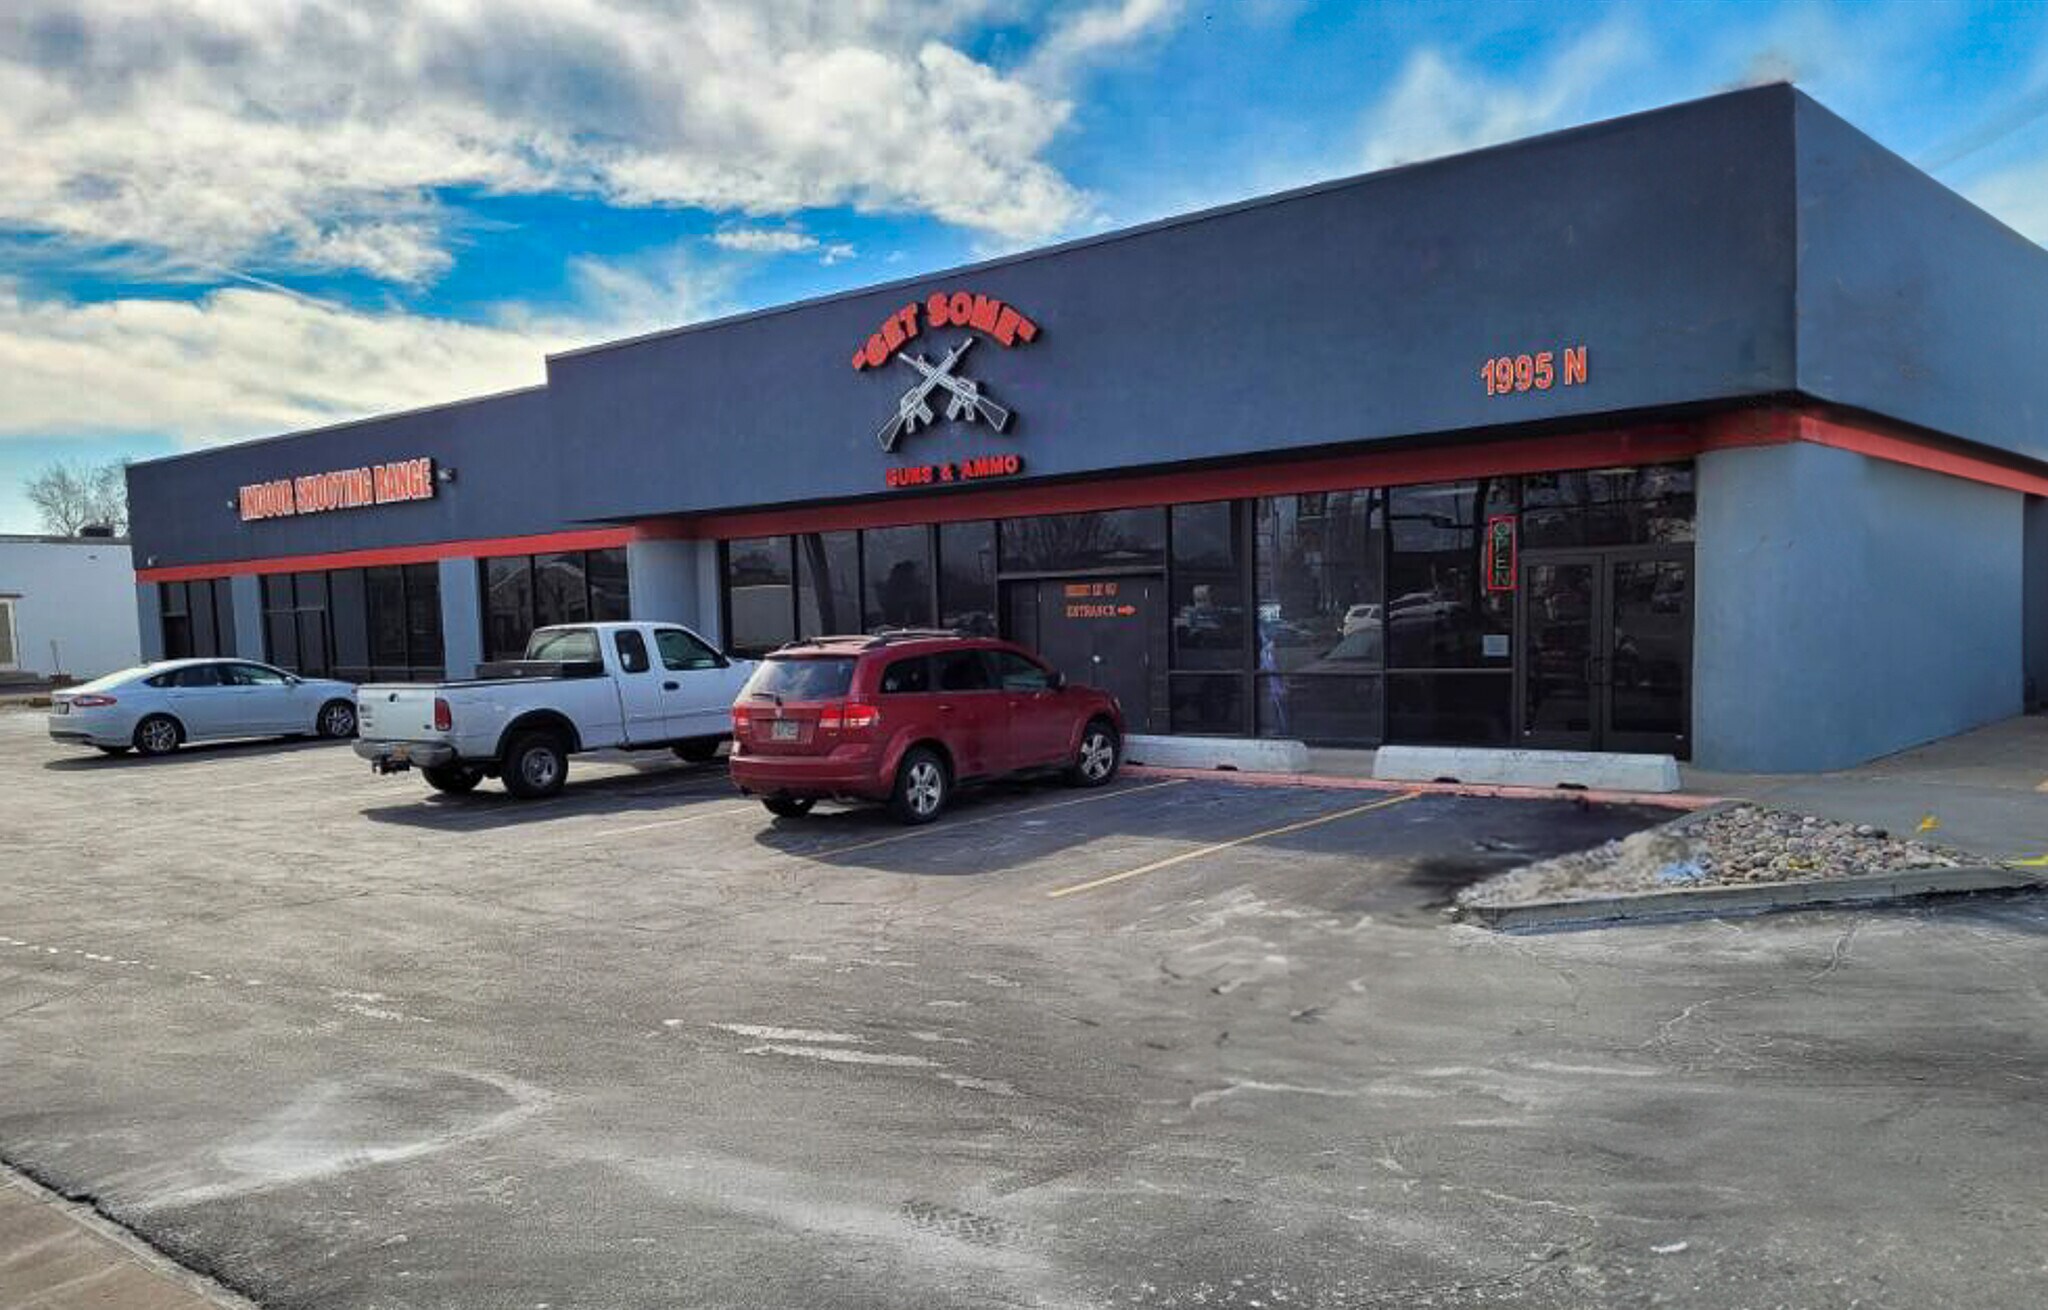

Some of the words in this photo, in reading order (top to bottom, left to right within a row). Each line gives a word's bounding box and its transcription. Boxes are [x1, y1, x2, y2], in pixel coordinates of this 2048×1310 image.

[1481, 351, 1554, 396] 1995
[1564, 345, 1587, 385] N
[239, 479, 295, 521] INDOOR
[294, 466, 373, 514] SHOOTING
[373, 456, 433, 504] RANGE
[886, 467, 932, 487] GUNS
[940, 464, 953, 481] &
[961, 454, 1020, 479] AMMO
